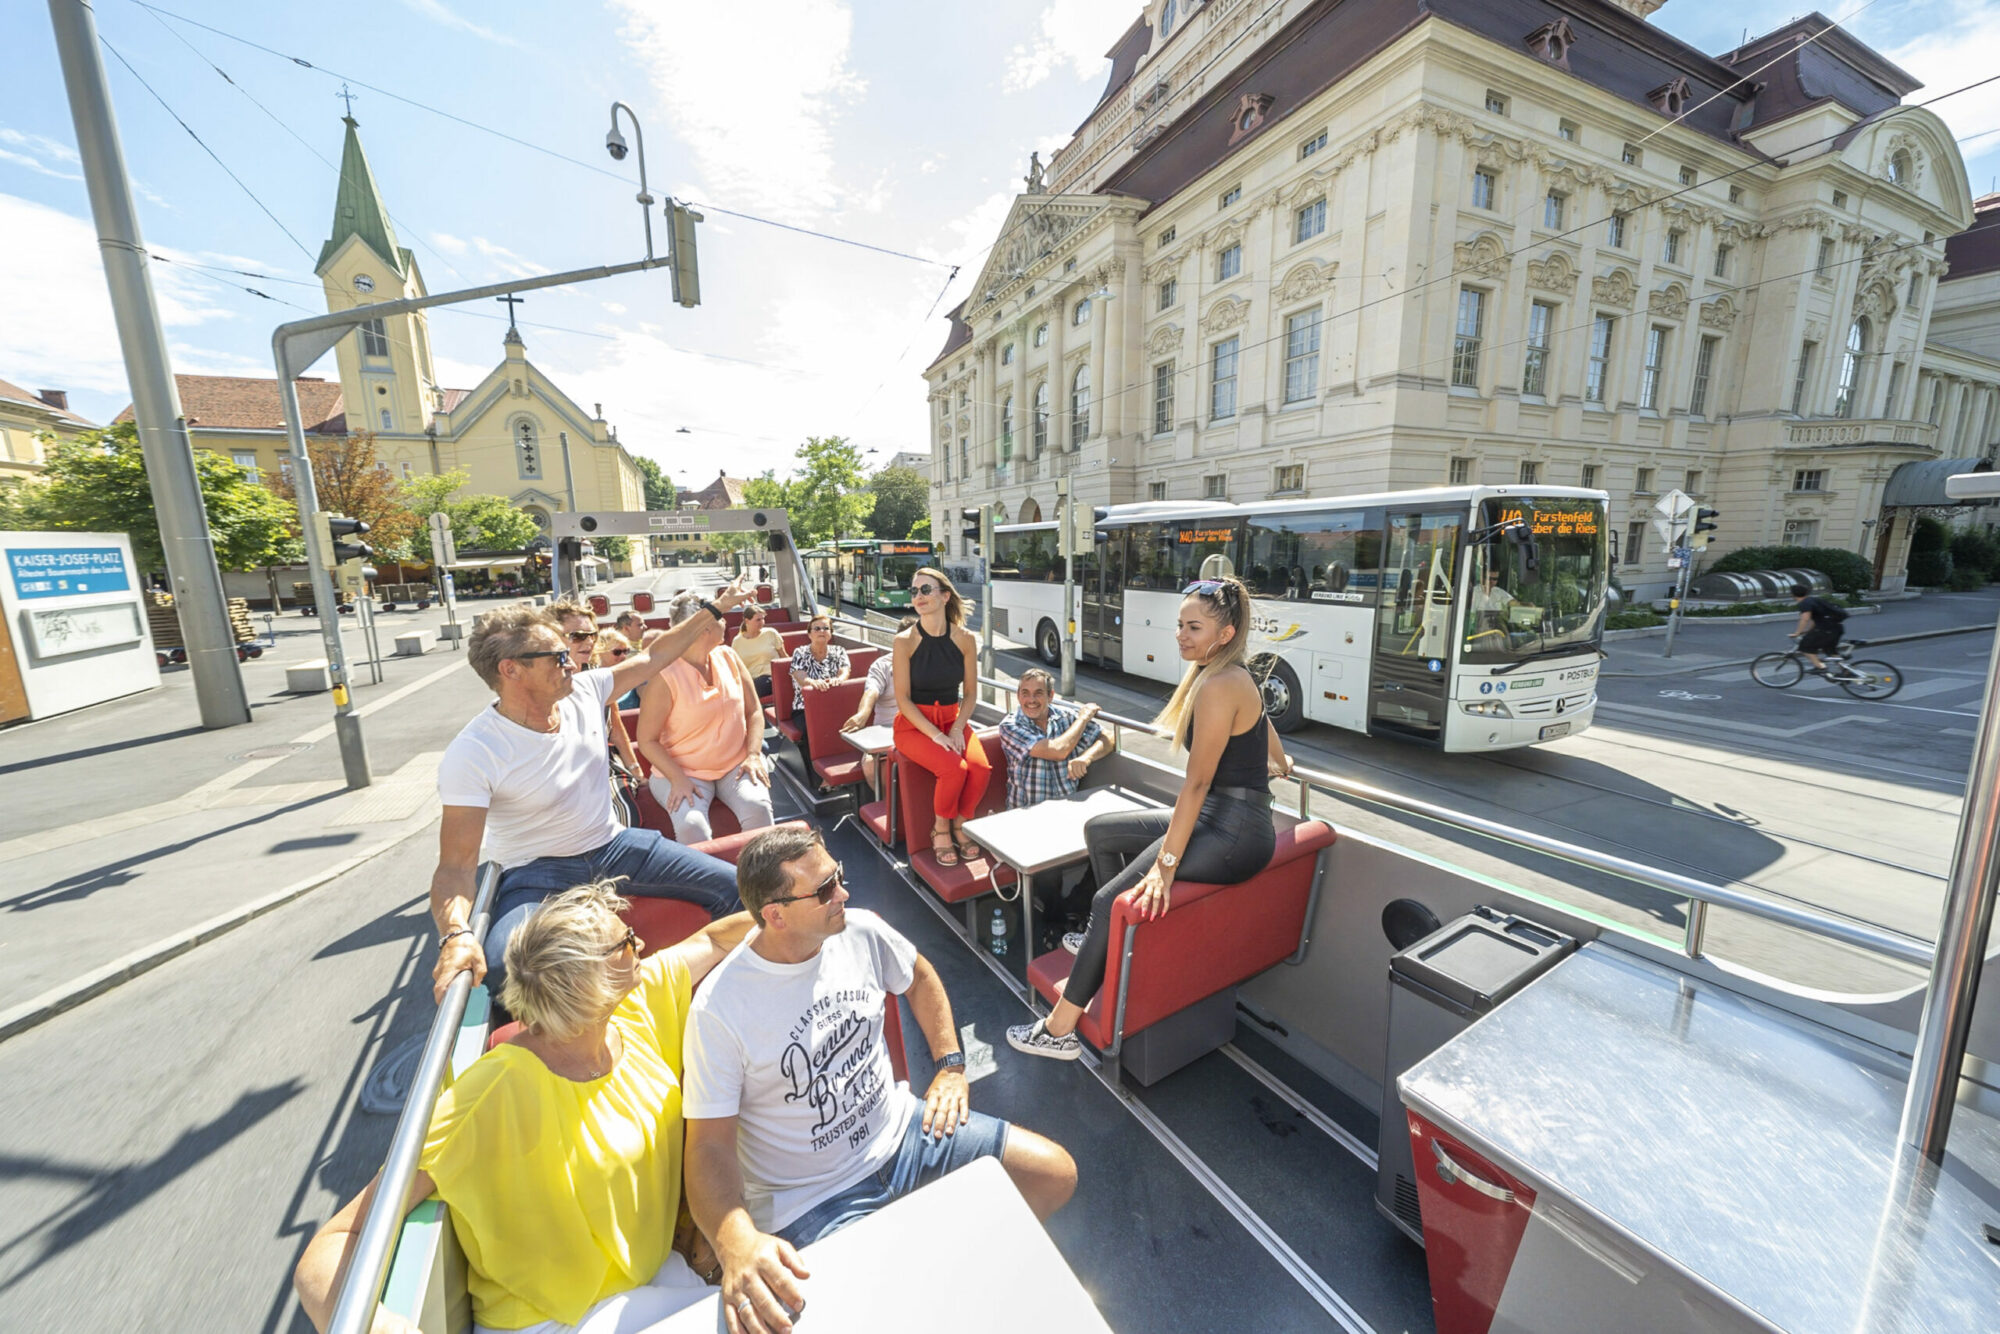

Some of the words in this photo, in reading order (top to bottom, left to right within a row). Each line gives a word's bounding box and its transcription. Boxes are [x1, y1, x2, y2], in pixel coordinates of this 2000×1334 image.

[1557, 523, 1573, 534] die
[1575, 523, 1598, 534] Ries
[13, 553, 120, 566] KAISER-JOSEF-PLATZ
[1567, 669, 1594, 680] POSTBUS
[789, 996, 831, 1041] CLASSIC
[836, 989, 870, 1004] CASUAL
[816, 1010, 842, 1030] GUESS
[780, 1009, 867, 1103] Denim
[808, 1020, 873, 1136] Brand
[811, 1114, 857, 1152] TRUSTED
[848, 1122, 870, 1150] 1981
